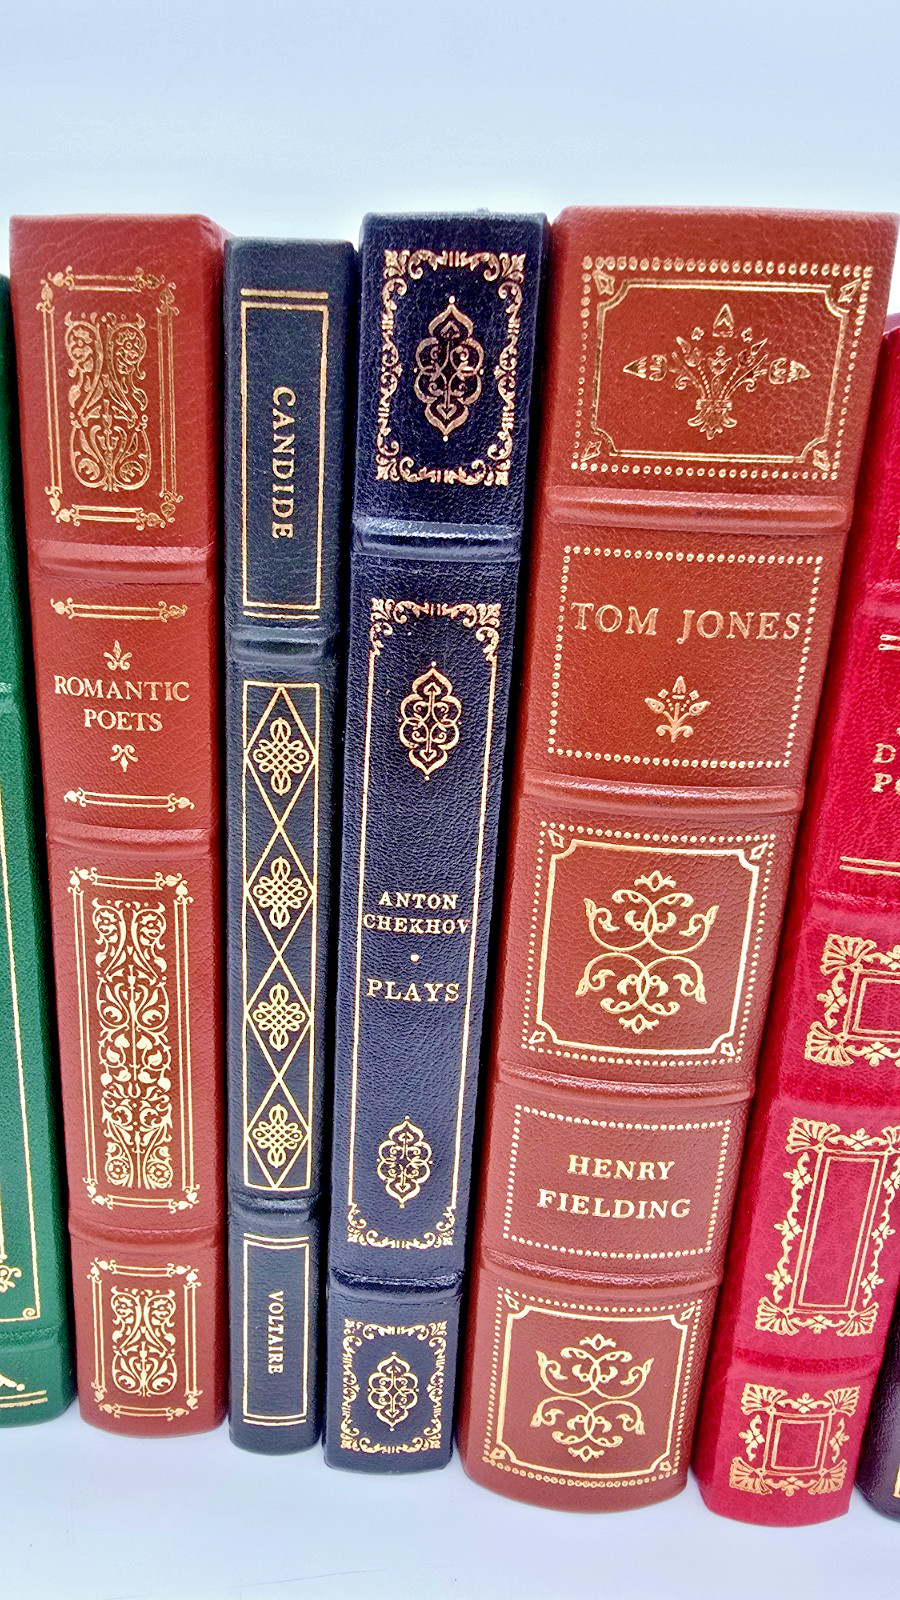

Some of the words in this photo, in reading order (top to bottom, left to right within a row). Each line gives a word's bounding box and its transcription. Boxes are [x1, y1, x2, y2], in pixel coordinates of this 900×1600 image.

[271, 386, 297, 539] CANDIDE
[570, 602, 659, 636] TOM
[676, 609, 801, 645] JONES
[54, 675, 190, 702] ROMANTIC
[83, 708, 163, 732] POETS
[871, 772, 900, 795] P
[379, 891, 459, 910] ANTON
[363, 913, 471, 935] CHEKHOV
[366, 978, 460, 1002] PLAYS
[566, 1154, 675, 1181] HENRY
[536, 1188, 691, 1220] FIELDING
[267, 1290, 284, 1375] VOLTAIRE
